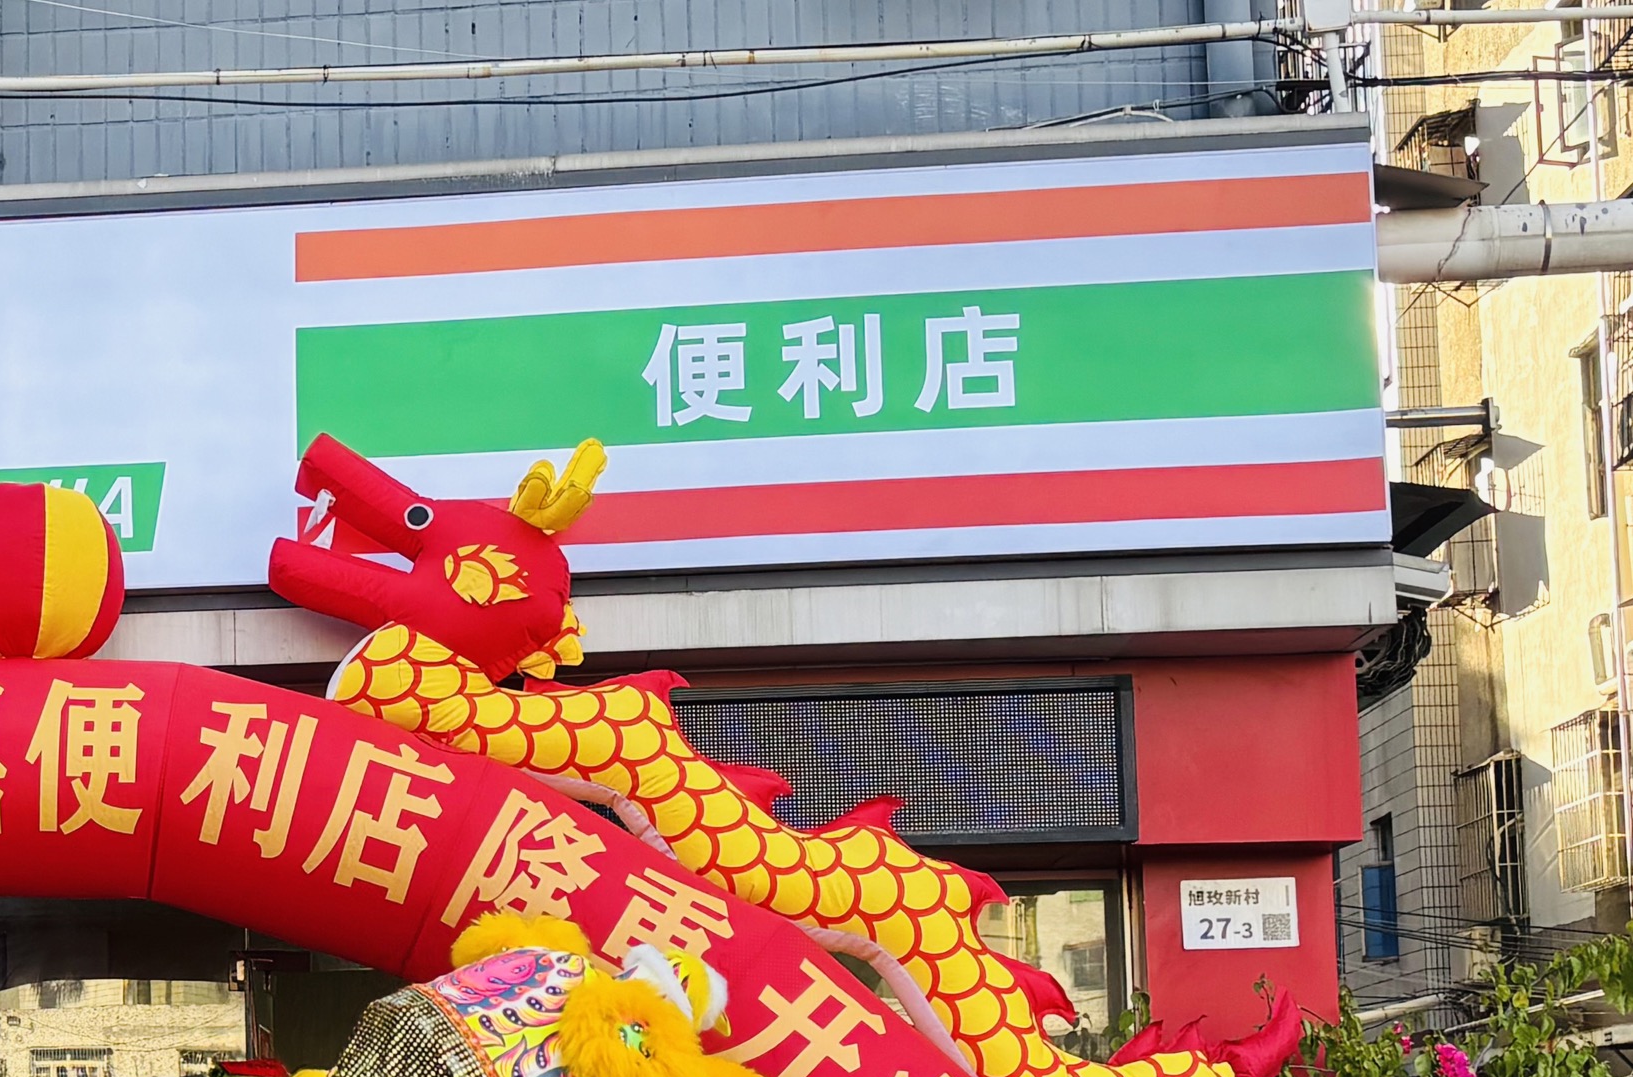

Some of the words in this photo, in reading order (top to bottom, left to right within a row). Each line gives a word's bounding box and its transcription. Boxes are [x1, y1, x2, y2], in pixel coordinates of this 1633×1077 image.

[641, 306, 1020, 427] 便利店
[1188, 888, 1260, 906] 旭玫新村
[1199, 918, 1253, 940] 27-3
